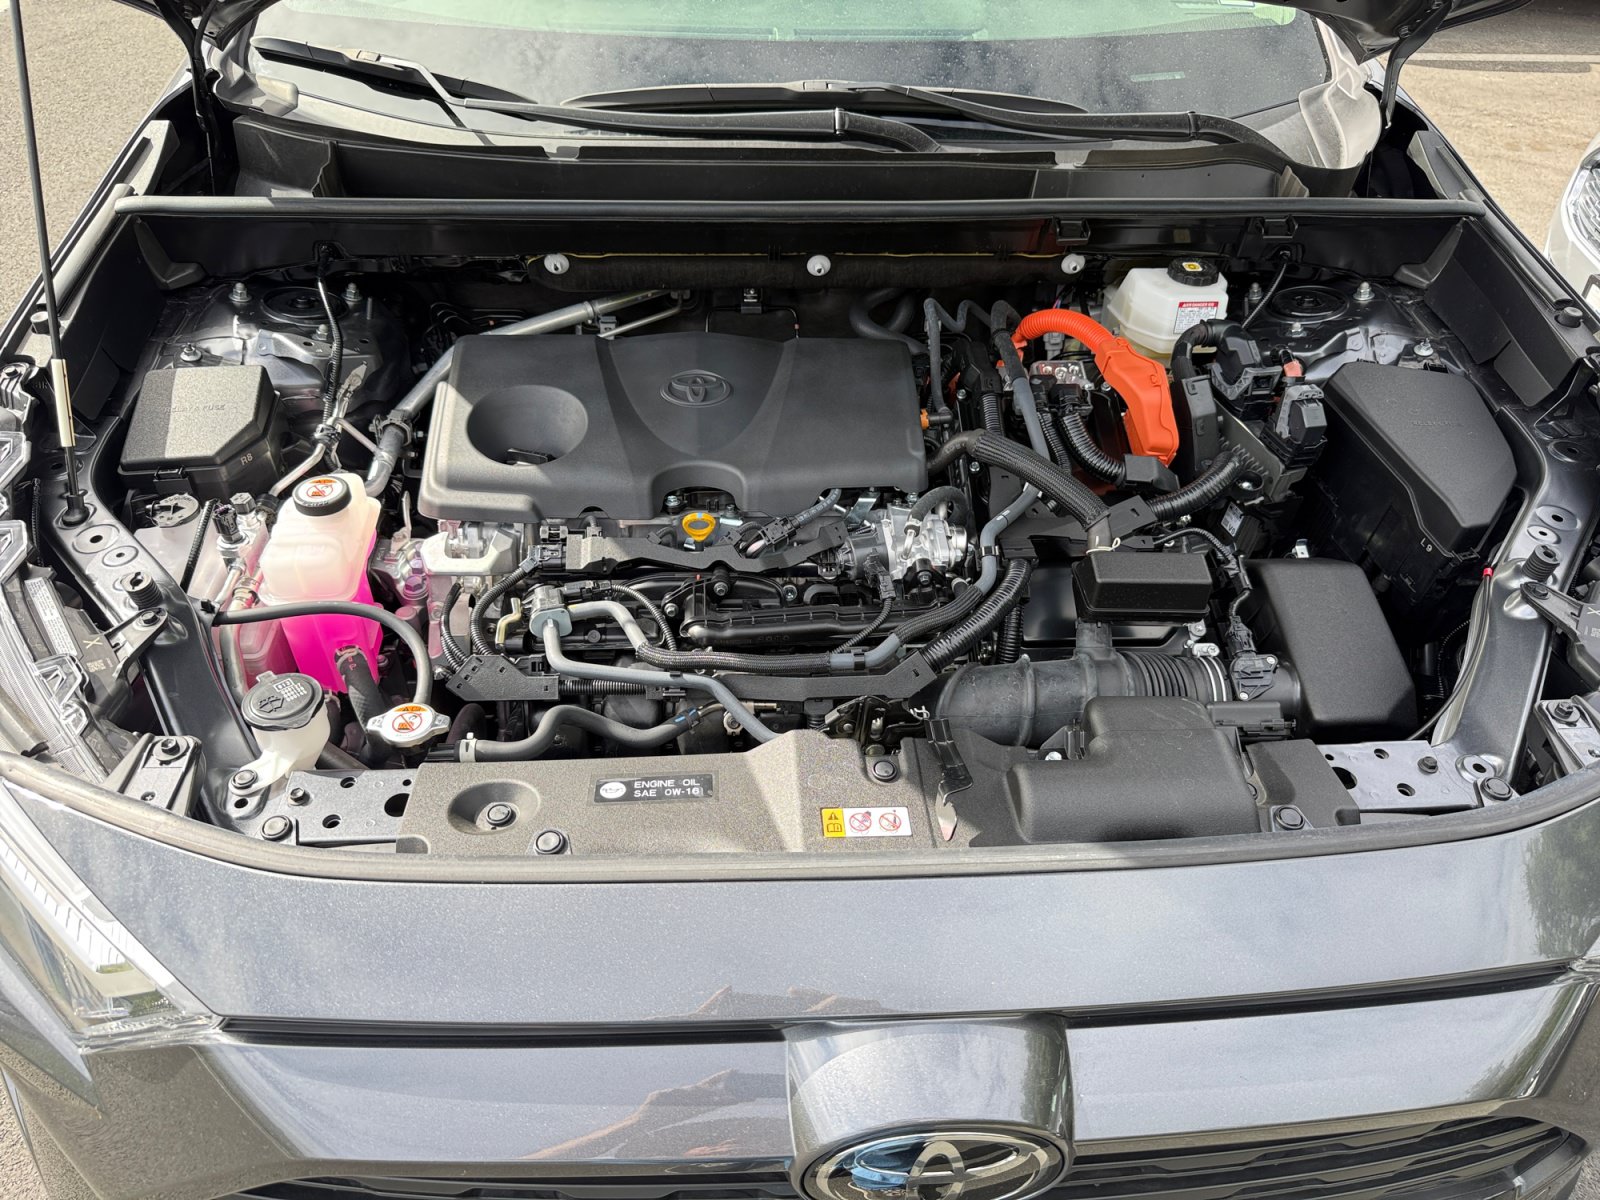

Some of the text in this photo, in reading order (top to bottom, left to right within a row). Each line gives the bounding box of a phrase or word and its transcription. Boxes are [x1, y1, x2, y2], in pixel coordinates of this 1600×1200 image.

[634, 778, 700, 789] ENGINE OIL
[633, 787, 701, 798] SAE 0W-16
